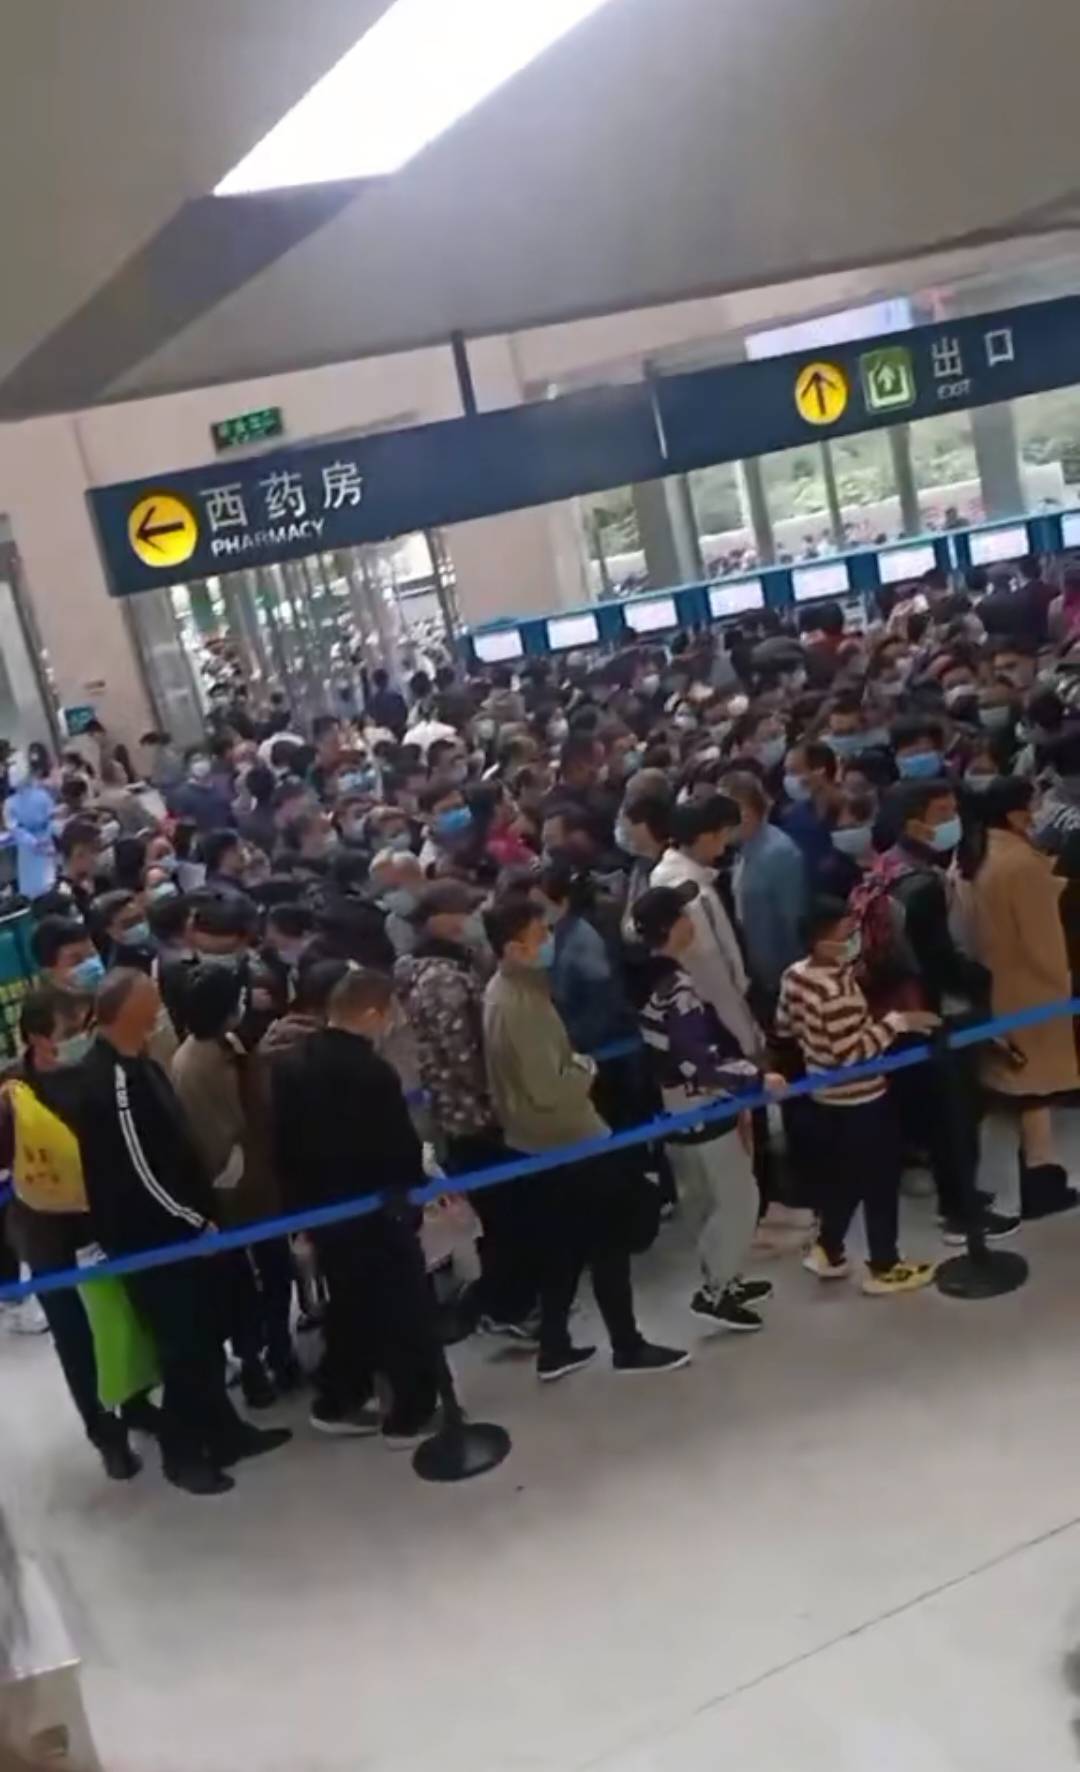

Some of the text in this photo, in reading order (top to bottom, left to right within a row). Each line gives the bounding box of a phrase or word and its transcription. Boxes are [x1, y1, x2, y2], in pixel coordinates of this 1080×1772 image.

[931, 327, 1014, 378] 出口
[937, 379, 971, 400] EXIT
[199, 460, 363, 532] 西药房
[210, 518, 325, 557] PHARMACY
